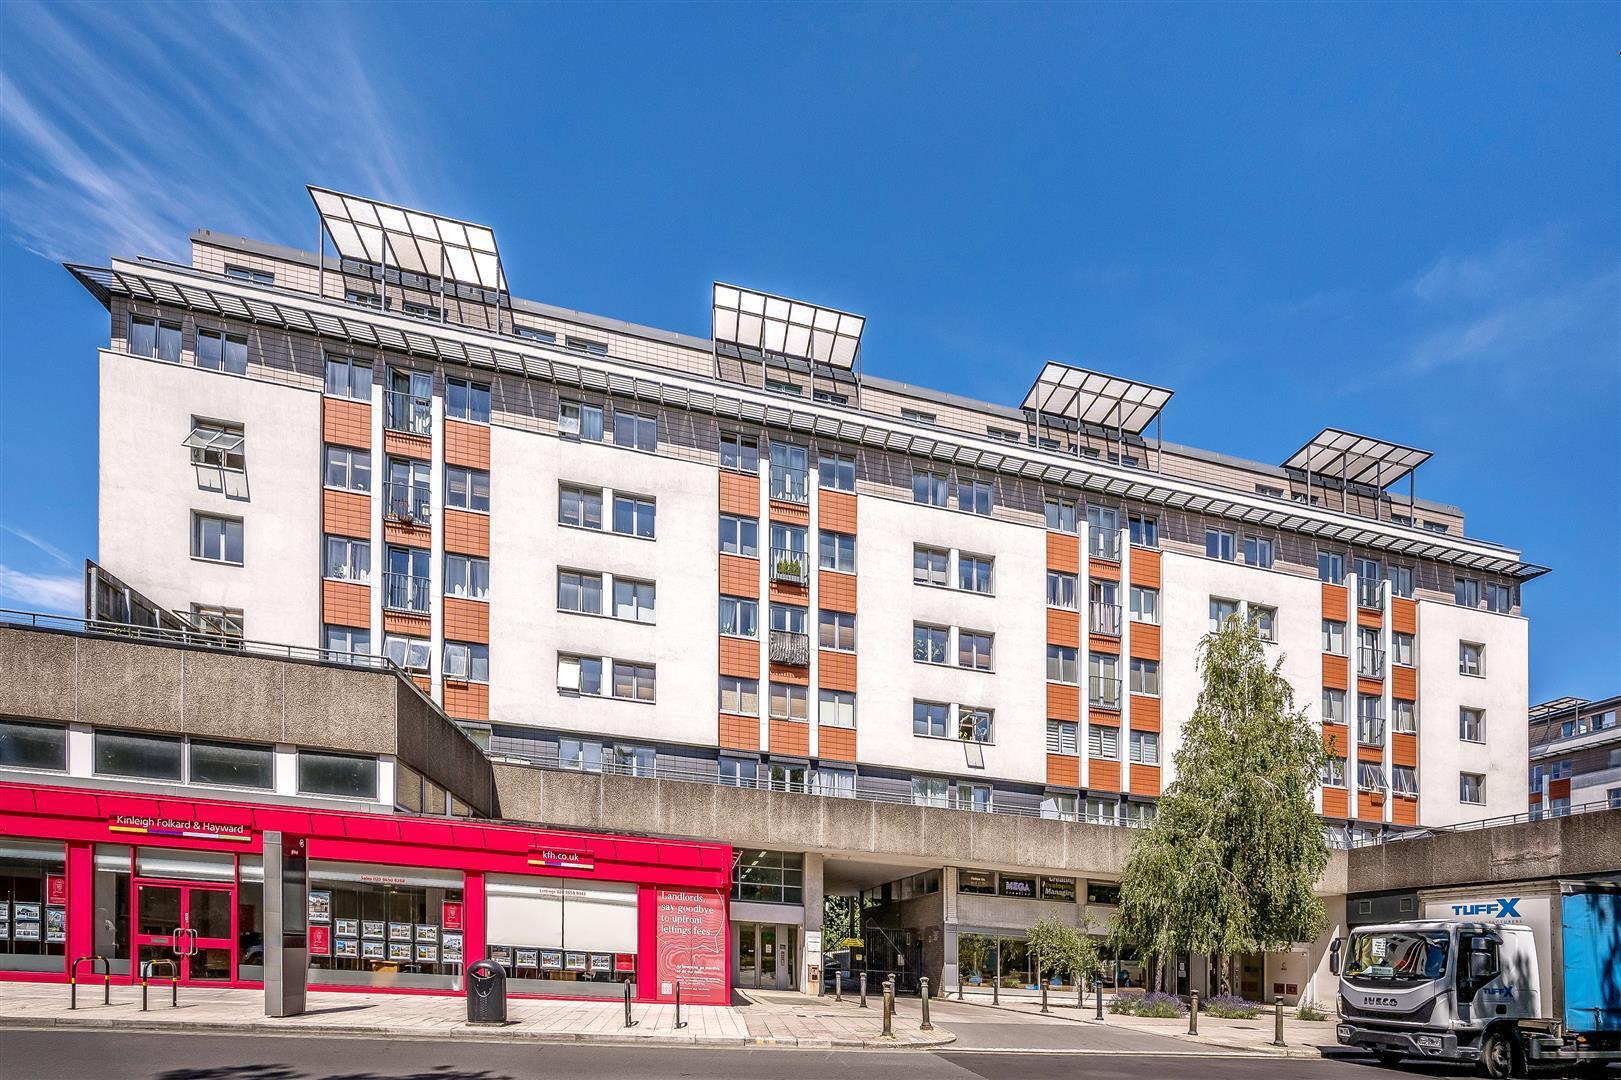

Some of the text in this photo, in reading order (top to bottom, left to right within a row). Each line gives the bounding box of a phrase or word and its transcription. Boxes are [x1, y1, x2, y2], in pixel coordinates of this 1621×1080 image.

[116, 815, 244, 834] Kinleigh Folkard & Hayward
[542, 850, 579, 861] kfh.co.uk
[1006, 881, 1030, 891] MEGA
[661, 891, 706, 903] Landlords,
[661, 904, 714, 916] say goodbye
[1451, 897, 1522, 919] TUFFX
[661, 914, 703, 925] to upfront
[661, 924, 713, 936] lettings fees.
[1483, 985, 1514, 998] TUFFX
[1363, 996, 1399, 1007] IVECO
